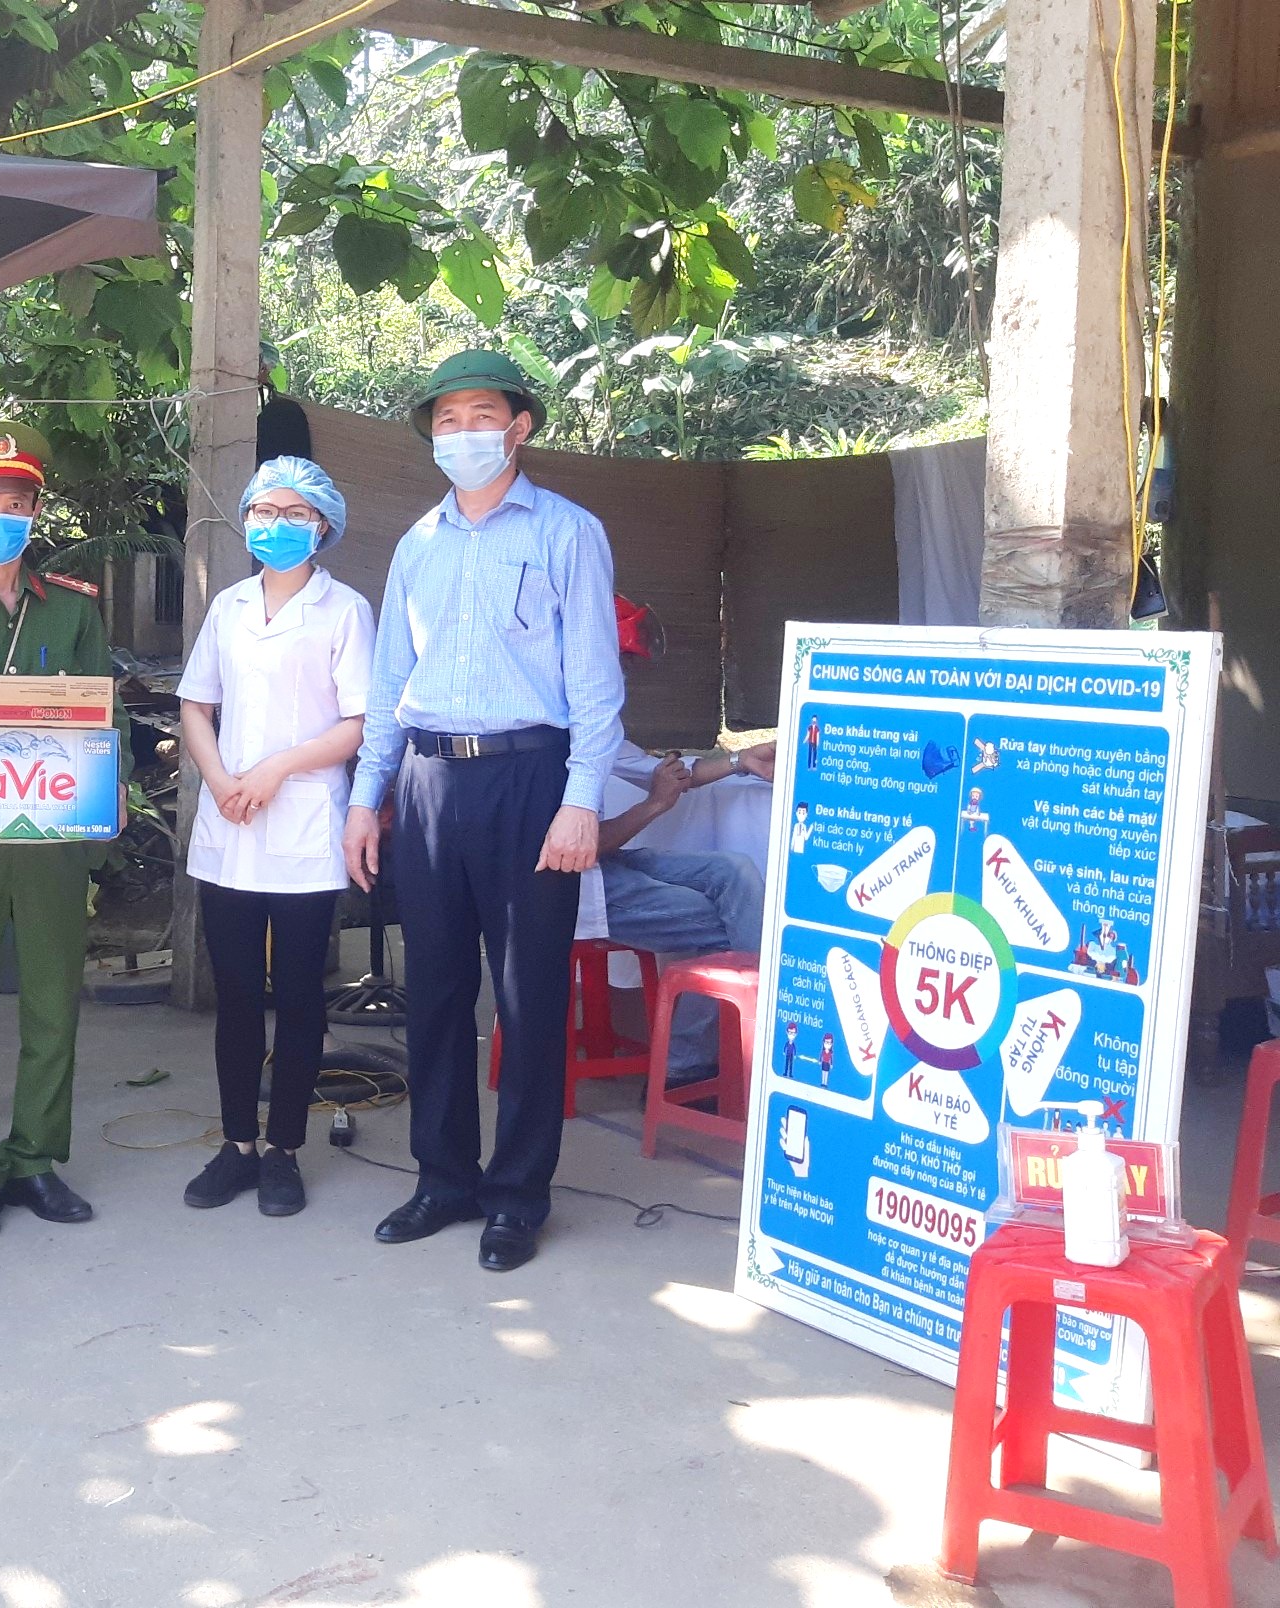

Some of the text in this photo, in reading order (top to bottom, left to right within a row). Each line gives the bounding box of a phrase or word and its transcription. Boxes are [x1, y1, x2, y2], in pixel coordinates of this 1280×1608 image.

[812, 664, 1160, 698] CHUNG AN TOÀN VỚI ĐẠI DỊCH COVID-19
[31, 708, 72, 719] KOKOMI
[83, 740, 111, 749] Nestlé
[824, 724, 843, 735] Đeo
[873, 729, 900, 743] trang
[822, 756, 844, 770] công
[859, 744, 886, 757] xuyên
[890, 747, 901, 759] tại
[904, 749, 919, 759] nơi
[1028, 741, 1046, 756] tay
[1050, 744, 1091, 761] thường
[1095, 749, 1131, 763] xuyên
[821, 772, 834, 781] nơi
[838, 772, 852, 786] tập
[855, 776, 878, 789] trung
[881, 777, 905, 792] đông
[1033, 760, 1069, 776] phòng
[1072, 762, 1101, 778] hoặc
[1105, 766, 1134, 782] dung
[1138, 769, 1164, 784] dịch
[1082, 782, 1162, 804] sát tay
[816, 804, 834, 816] Đeo
[864, 811, 890, 826] trang
[894, 817, 899, 827] y
[902, 813, 912, 827] tế
[1034, 800, 1105, 819] Vệ sinh các
[814, 822, 881, 842] tại các cơ y
[1022, 816, 1157, 844] vật dụng thường xuyên
[813, 836, 864, 856] khu cách ly
[1109, 841, 1156, 861] tiếp xúc
[893, 842, 931, 876] TRANG
[1059, 864, 1073, 878] vệ
[1110, 870, 1128, 884] lau
[1102, 887, 1124, 901] nhà
[1072, 899, 1150, 926] thông thoáng
[909, 941, 992, 973] THÔNG ĐIỆP
[793, 975, 825, 993] cách khi
[795, 993, 809, 1007] xúc
[915, 967, 978, 1025] 5K
[804, 1013, 823, 1028] khác
[1094, 1032, 1138, 1058] Không
[1098, 1054, 1136, 1078] tụ tập
[909, 1072, 970, 1113] KHAI BÁO
[1056, 1066, 1135, 1096] đông người
[934, 1111, 941, 1124] Y
[901, 1132, 912, 1145] khi
[944, 1145, 961, 1161] hiệu
[904, 1149, 919, 1165] HO,
[962, 1170, 976, 1182] gọi
[767, 1178, 833, 1210] Thực hiện khai báo
[956, 1182, 968, 1198] Bộ
[970, 1187, 977, 1196] Y
[764, 1194, 769, 1204] y
[794, 1203, 808, 1218] App
[810, 1208, 833, 1225] NCOVI
[875, 1187, 976, 1247] 19009095
[867, 1229, 886, 1245] hoặc
[888, 1239, 899, 1249] cơ
[901, 1243, 920, 1257] quan
[922, 1251, 927, 1262] y
[939, 1256, 950, 1269] địa
[897, 1256, 917, 1272] được
[881, 1266, 945, 1299] đi khám bệnh an
[788, 1260, 804, 1282] Hãy
[821, 1278, 832, 1290] an
[834, 1280, 852, 1299] toàn
[854, 1288, 870, 1306] cho
[873, 1293, 889, 1315] Bạn
[892, 1303, 902, 1319] và
[905, 1310, 932, 1336] chúng
[935, 1320, 943, 1336] ta
[1062, 1314, 1077, 1328] báo
[1079, 1323, 1099, 1338] nguy
[1058, 1328, 1096, 1351] COVID-19
